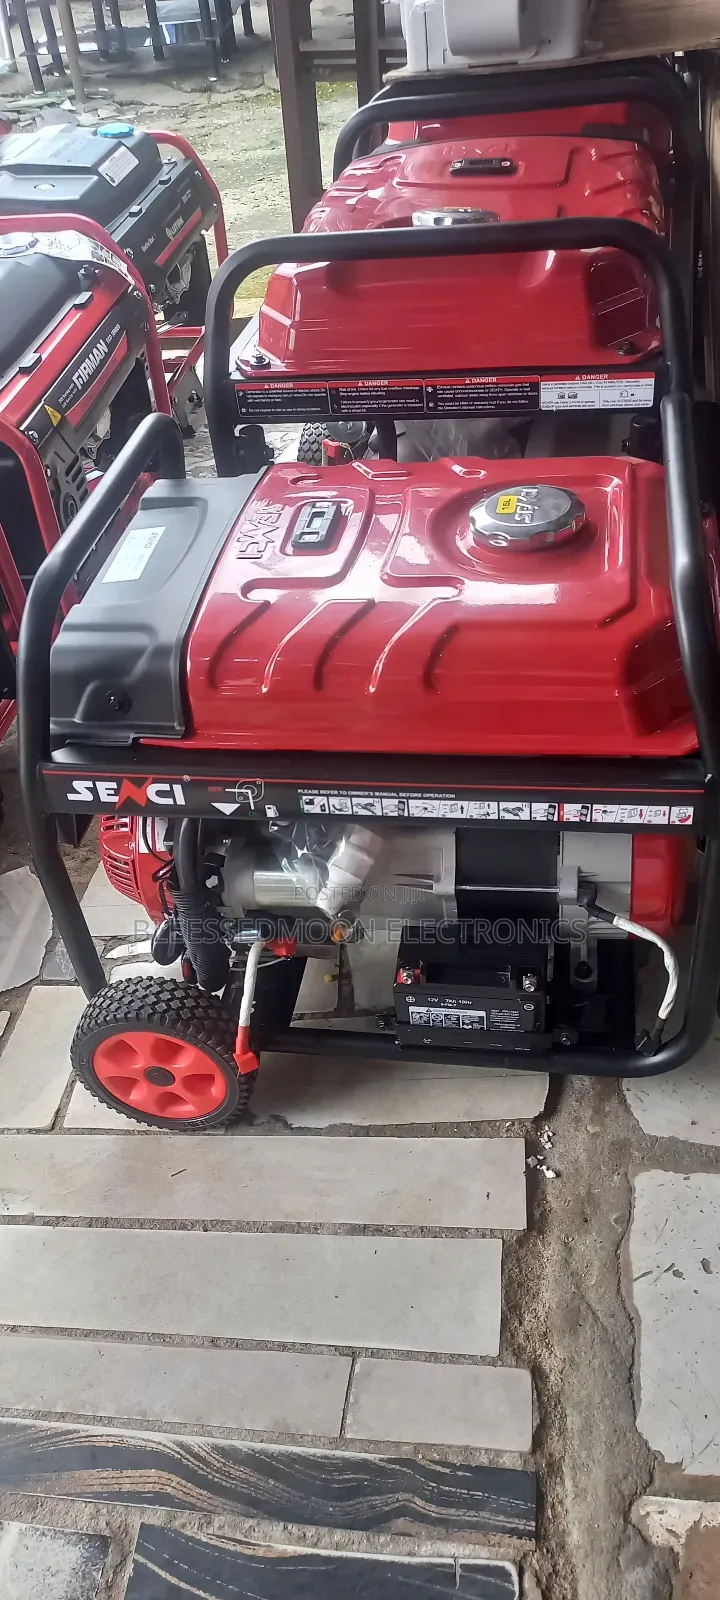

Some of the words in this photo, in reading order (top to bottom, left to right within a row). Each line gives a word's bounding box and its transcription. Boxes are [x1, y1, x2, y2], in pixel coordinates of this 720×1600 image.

[72, 339, 108, 390] FIRMAN
[502, 499, 512, 510] 15L
[66, 777, 185, 810] SENCI
